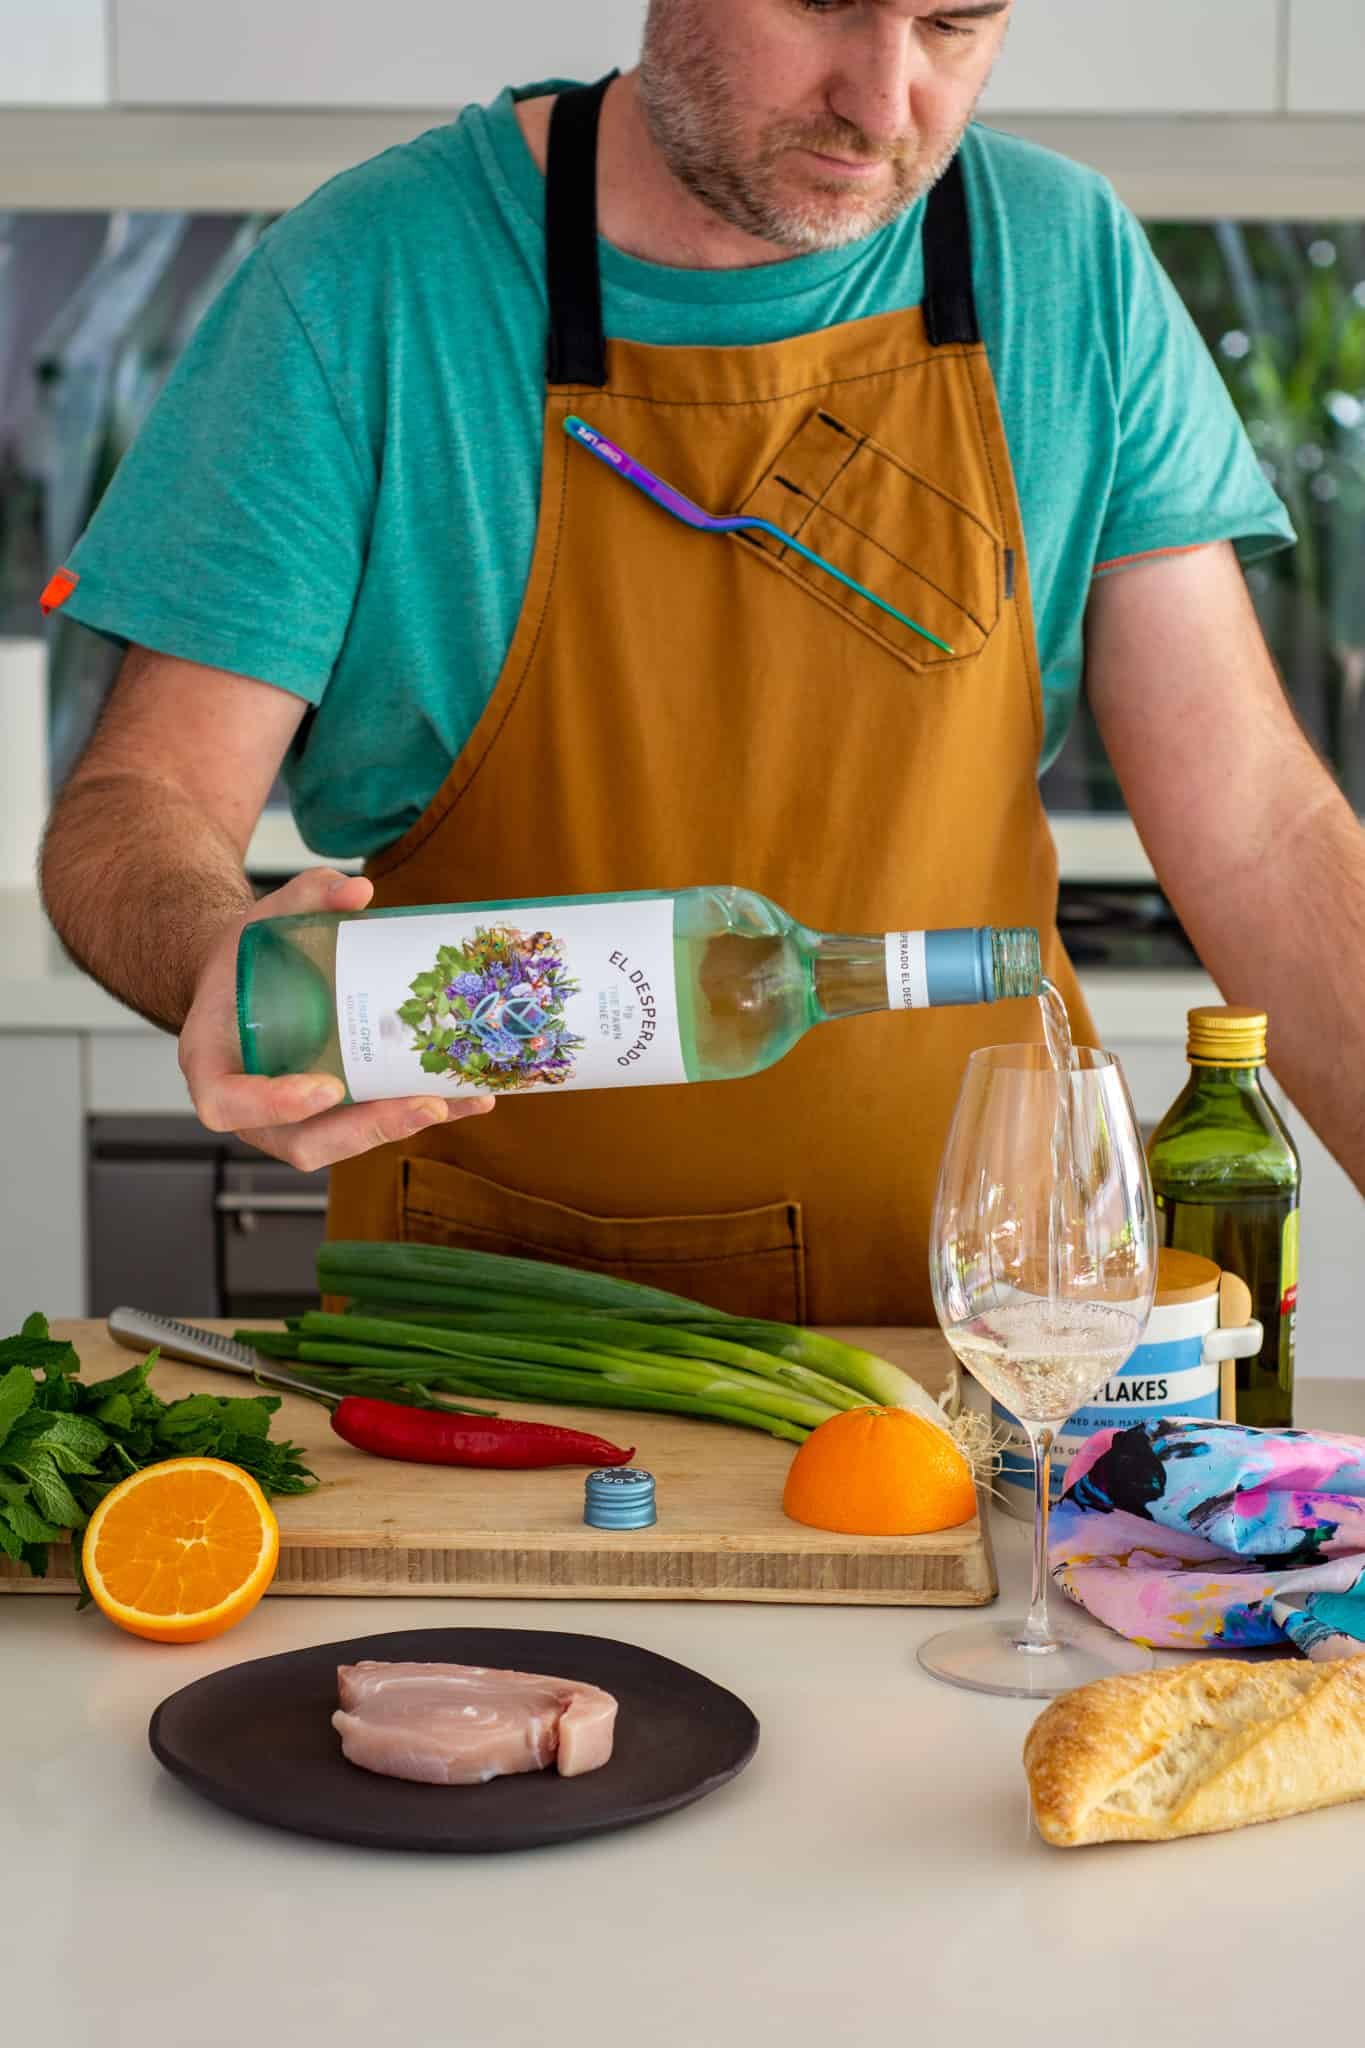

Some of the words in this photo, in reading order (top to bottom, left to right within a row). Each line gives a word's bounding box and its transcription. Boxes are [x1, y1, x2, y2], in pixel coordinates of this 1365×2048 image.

[608, 949, 629, 973] EL
[901, 972, 911, 985] EL
[616, 969, 657, 1067] DESPERADO
[1093, 1418, 1114, 1427] AND
